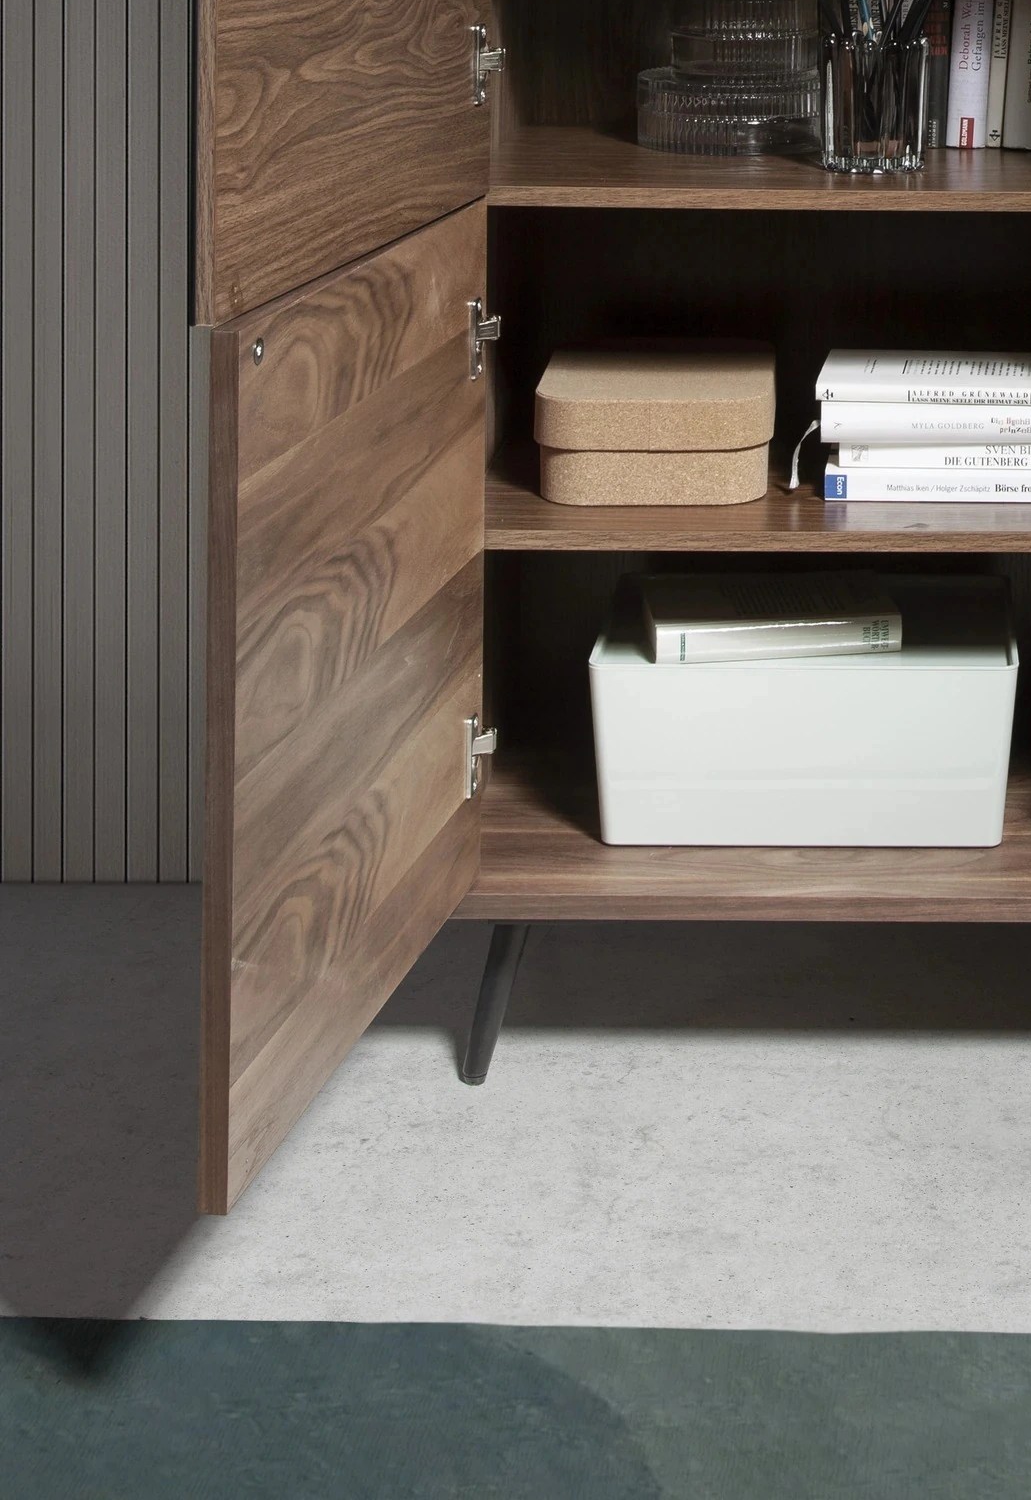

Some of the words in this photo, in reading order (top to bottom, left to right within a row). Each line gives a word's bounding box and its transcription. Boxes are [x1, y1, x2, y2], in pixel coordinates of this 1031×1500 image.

[974, 2, 985, 16] im
[994, 13, 1003, 55] ALFRED
[959, 24, 971, 70] Deborah
[971, 20, 986, 71] Gefangen
[960, 118, 968, 146] GOLDMANN
[962, 390, 1029, 398] GRÜNEWALD
[911, 422, 935, 430] MYLA
[937, 422, 985, 430] GOLDBERG
[985, 445, 1017, 456] SVEN
[944, 457, 962, 466] DIE
[964, 457, 1028, 467] GUTENBERG
[836, 476, 845, 495] Econ
[886, 484, 914, 492] Matthias
[915, 484, 930, 492] Iken
[936, 484, 958, 494] Holger
[994, 484, 1019, 493] Börse
